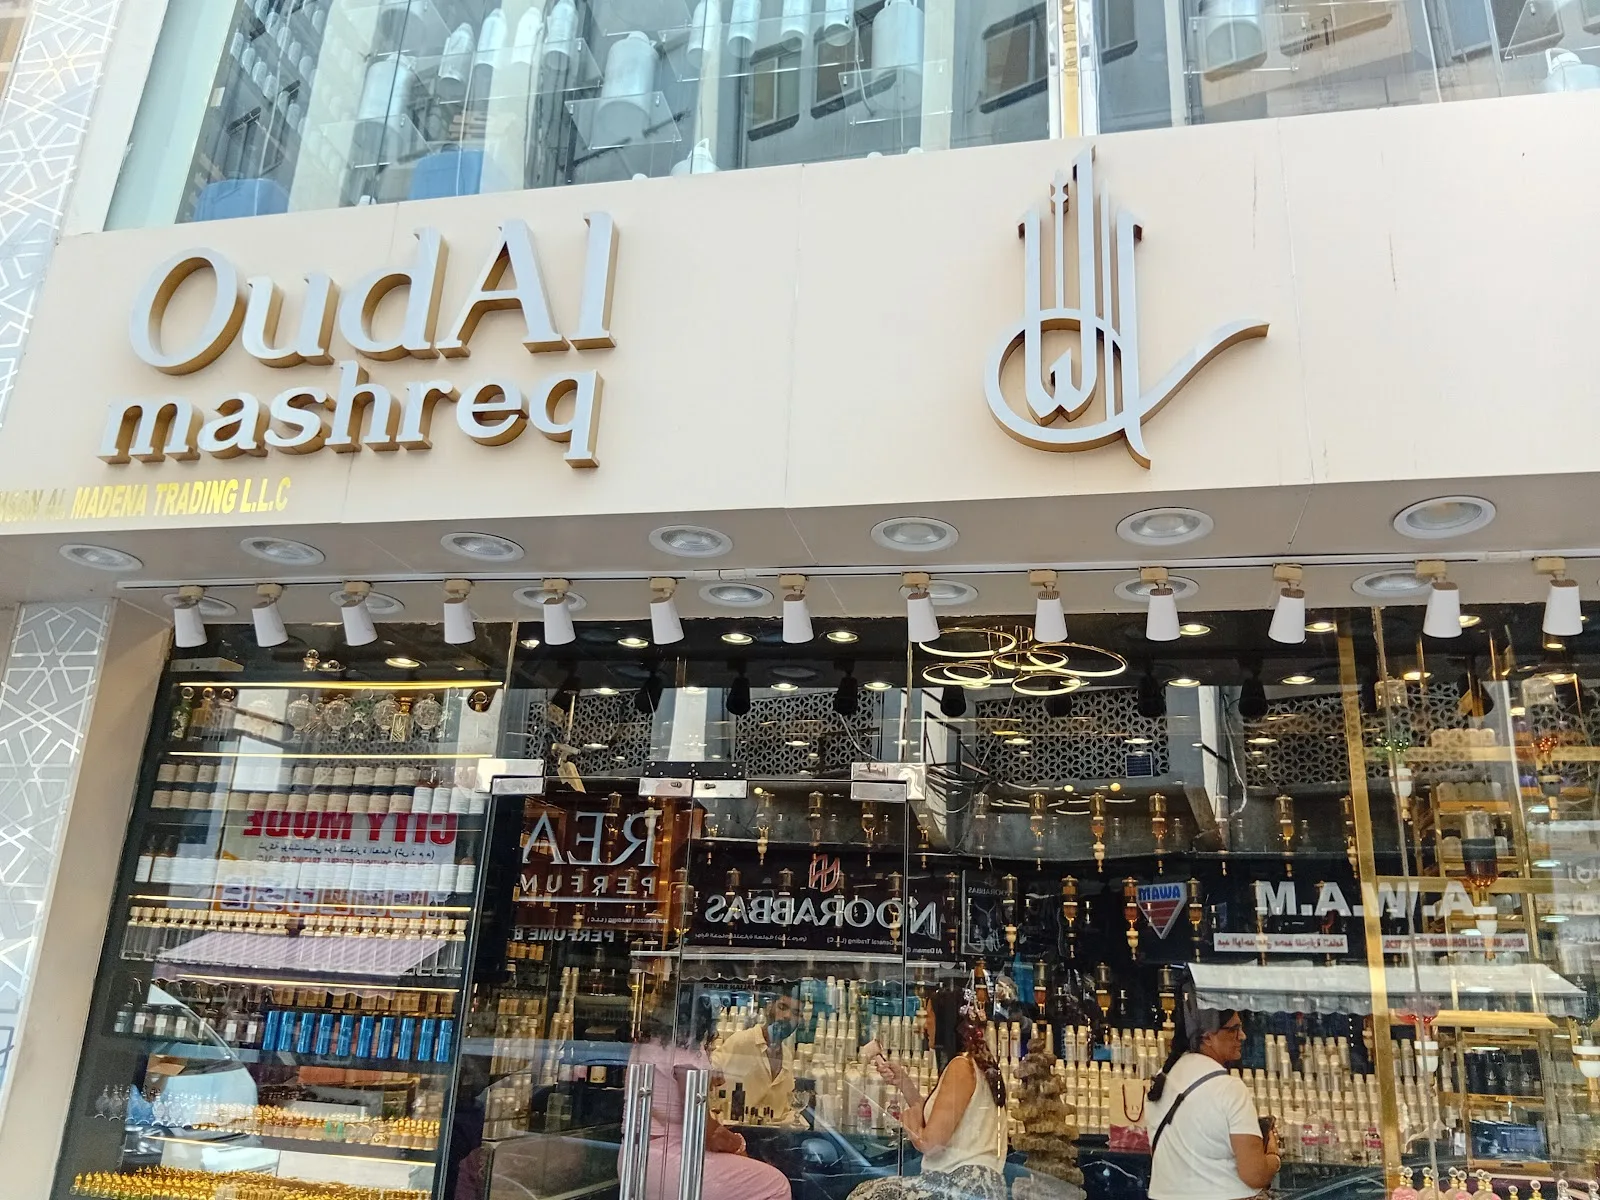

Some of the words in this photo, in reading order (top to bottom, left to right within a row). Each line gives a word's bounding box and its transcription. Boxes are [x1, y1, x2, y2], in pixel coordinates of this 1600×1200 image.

[97, 361, 603, 468] mashreq
[71, 485, 148, 519] MADENA
[153, 479, 238, 516] TRADING
[239, 477, 291, 513] L.L.C
